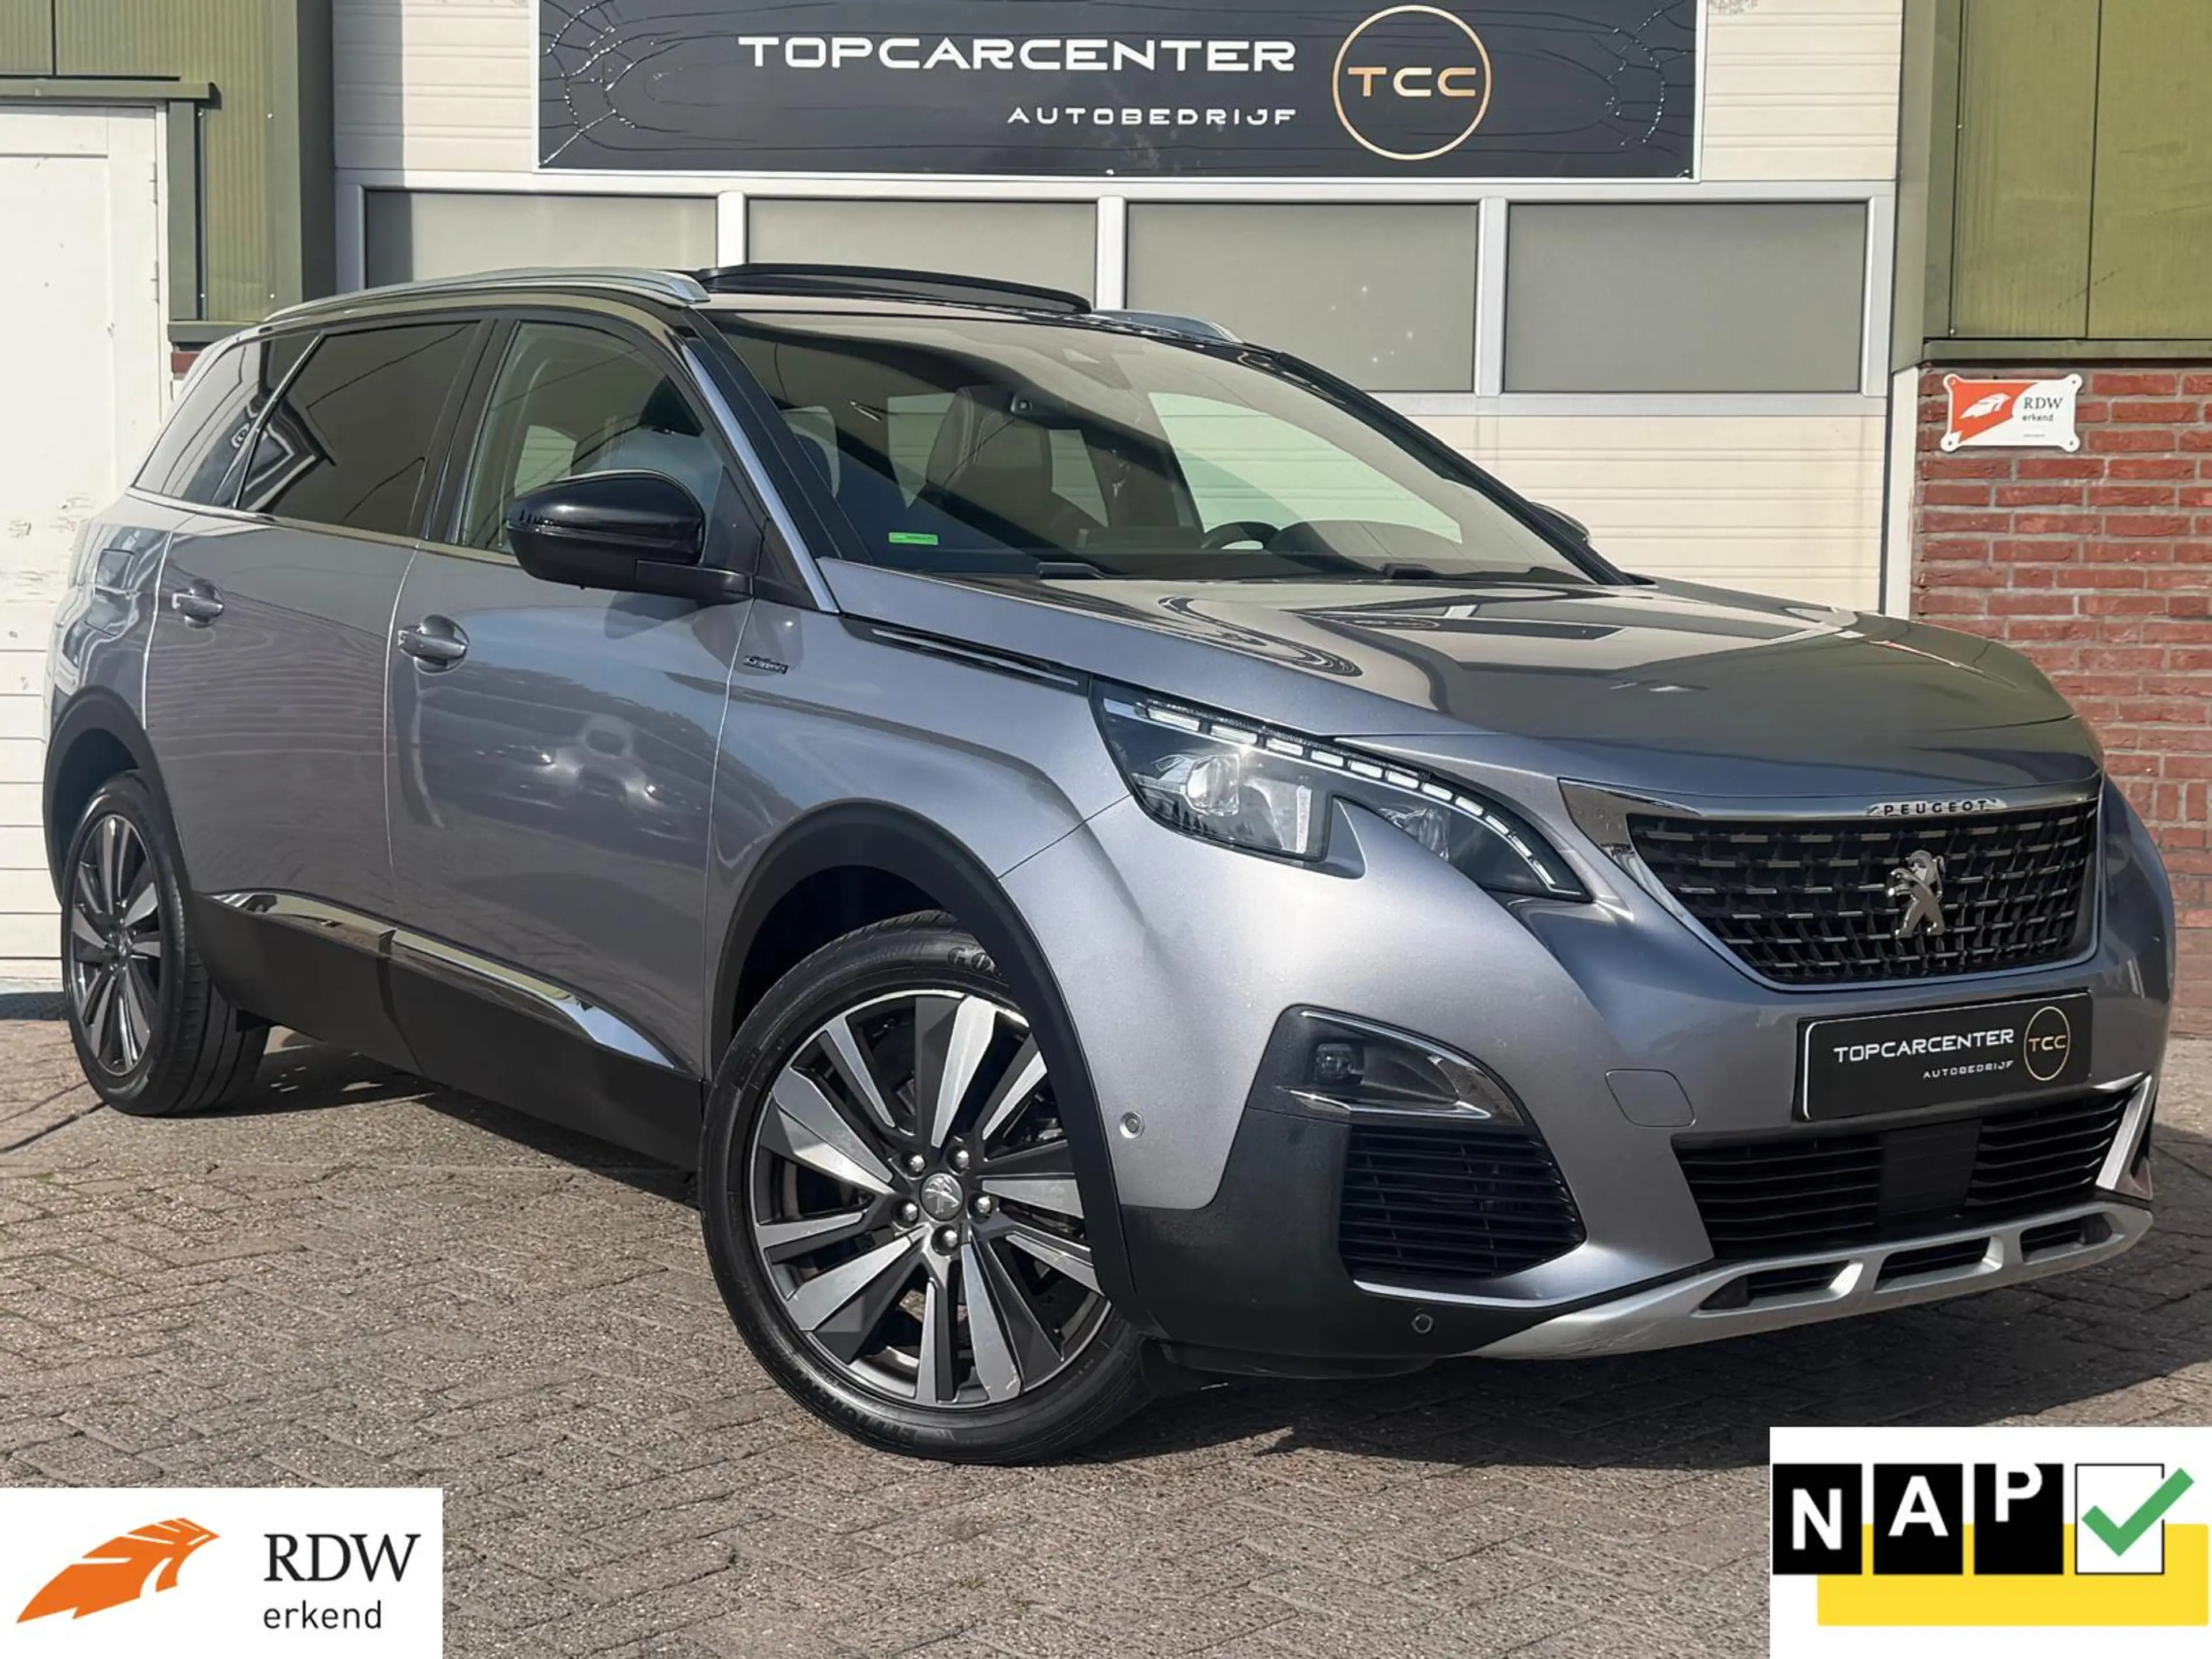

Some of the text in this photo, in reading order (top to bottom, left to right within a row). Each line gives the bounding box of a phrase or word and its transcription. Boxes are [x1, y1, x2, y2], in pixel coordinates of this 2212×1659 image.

[738, 36, 1296, 71] TOPCARCENTER
[1347, 67, 1476, 97] TCC
[1007, 107, 1296, 126] AUTOBEDRIJF
[2022, 396, 2064, 410] RDW
[2022, 413, 2054, 422] erkend
[1884, 800, 1987, 816] PEUGEOT
[1833, 1028, 2014, 1062] TOPCARCENTER
[2028, 1035, 2067, 1052] TCC
[1922, 1060, 2014, 1079] AUTOBEDRIJF
